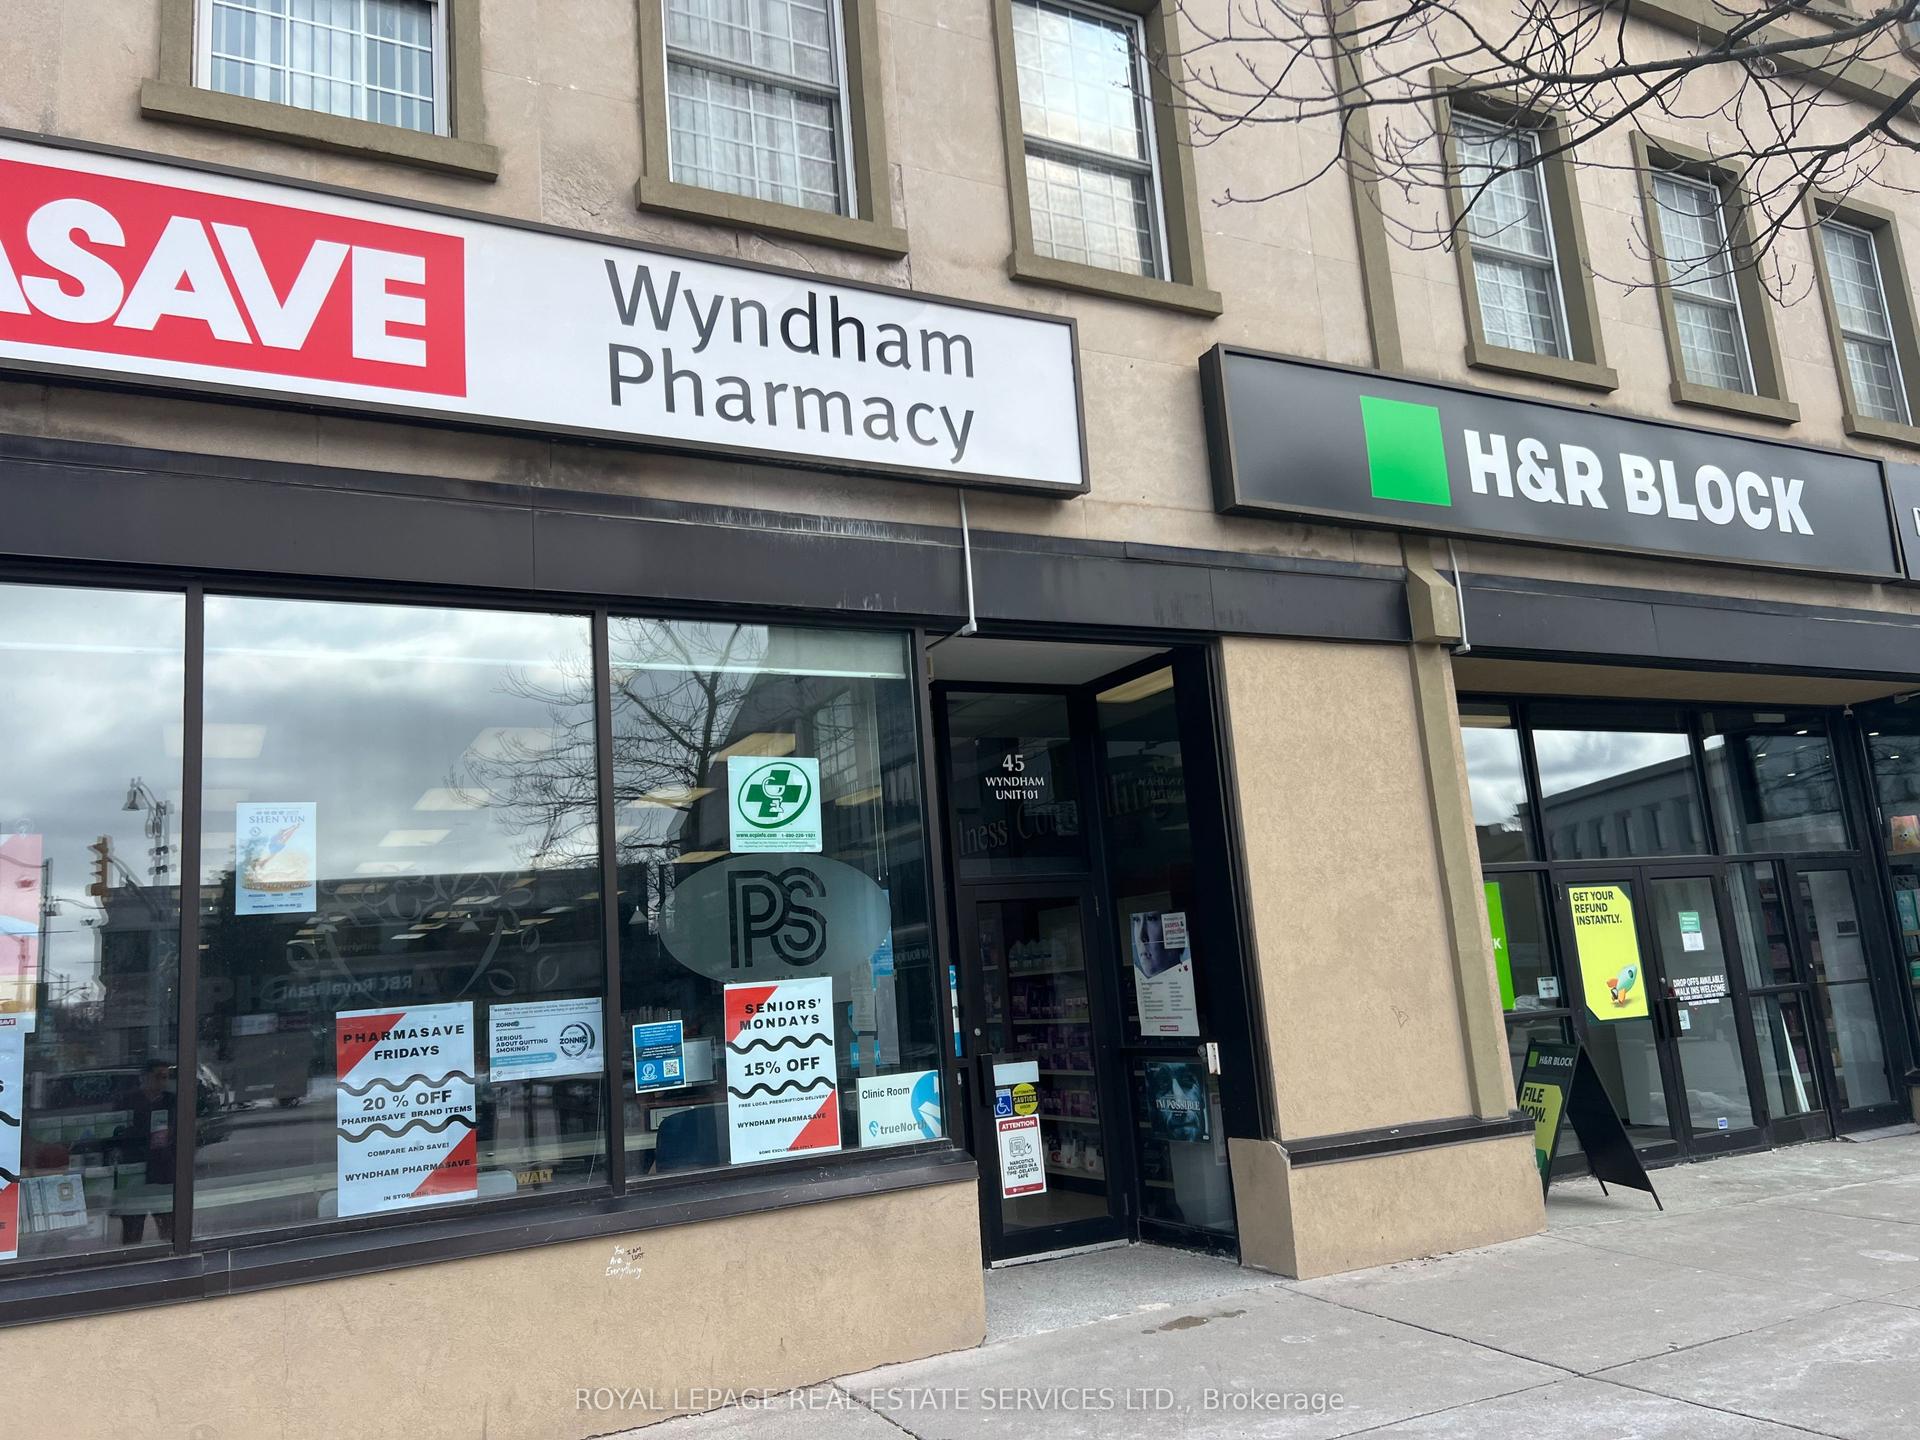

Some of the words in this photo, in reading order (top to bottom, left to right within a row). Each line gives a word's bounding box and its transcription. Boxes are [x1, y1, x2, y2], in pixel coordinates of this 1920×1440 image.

[0, 198, 427, 368] SAVE
[604, 258, 975, 378] Wyndham
[607, 342, 975, 465] Pharmacy
[1463, 428, 1608, 509] H&R
[1618, 452, 1814, 536] BLOCK
[1002, 754, 1025, 772] 45
[985, 776, 1045, 787] WYNDHAM
[995, 790, 1039, 800] UNIT101
[249, 815, 280, 824] SHEN
[282, 815, 306, 824] YUN
[1572, 891, 1589, 902] GET
[1590, 890, 1614, 901] YOUR
[1574, 902, 1608, 913] REFUND
[727, 866, 827, 969] PS
[1576, 913, 1623, 925] INSTANTLY.
[1673, 978, 1687, 988] DROP
[1674, 986, 1691, 996] WALK
[1700, 983, 1726, 994] WELCOME
[745, 998, 822, 1014] SENIORS'
[740, 1014, 820, 1031] MONDAYS
[343, 1024, 465, 1044] PHARMASAVE
[560, 1036, 588, 1045] ZONNIC
[374, 1045, 440, 1060] FRIDAYS
[495, 1045, 529, 1053] SMOKING?
[744, 1061, 781, 1076] 15%
[786, 1056, 820, 1072] OFF
[1539, 1055, 1552, 1065] H&R
[1553, 1057, 1574, 1067] BLOCK
[861, 1087, 885, 1100] Clinic
[887, 1085, 910, 1097] Room
[1522, 1087, 1545, 1103] FILE
[363, 1096, 386, 1111] 20
[392, 1094, 409, 1108] %
[415, 1090, 452, 1105] OFF
[769, 1096, 805, 1105] PRESCRIPTION
[341, 1112, 406, 1126] PHARMASAVE
[411, 1108, 443, 1118] BRAND
[445, 1105, 473, 1114] ITEMS
[737, 1118, 776, 1128] WYNDHAM
[777, 1112, 827, 1124] PHARMASAVE
[879, 1120, 927, 1135] trueNorth
[1001, 1119, 1035, 1130] ATTENTION
[367, 1147, 406, 1157] COMPARE
[408, 1145, 425, 1153] AND
[427, 1142, 450, 1150] SAVE!
[1009, 1158, 1034, 1166] NARCOTICS
[345, 1168, 399, 1182] WYNDHAM
[402, 1159, 471, 1174] PHARMASAVE
